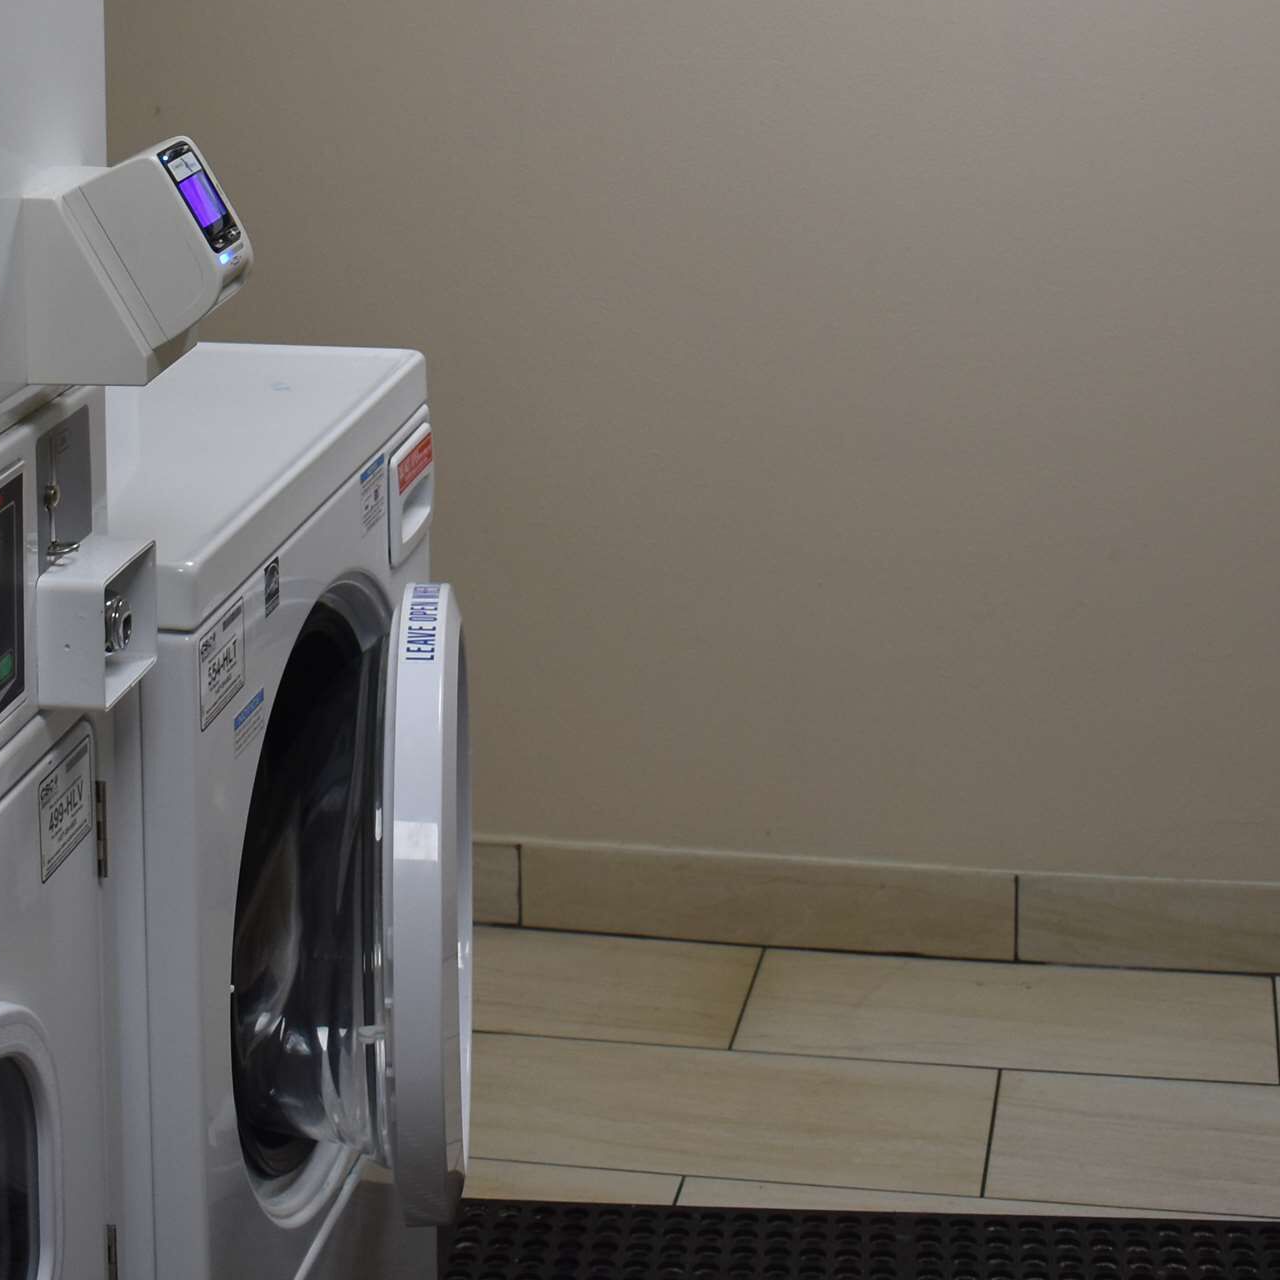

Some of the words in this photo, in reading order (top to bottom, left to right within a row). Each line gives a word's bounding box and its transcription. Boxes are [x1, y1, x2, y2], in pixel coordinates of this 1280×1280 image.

[409, 601, 439, 622] OPEN
[405, 625, 436, 660] LEAVE
[48, 779, 84, 833] 499-HLV
